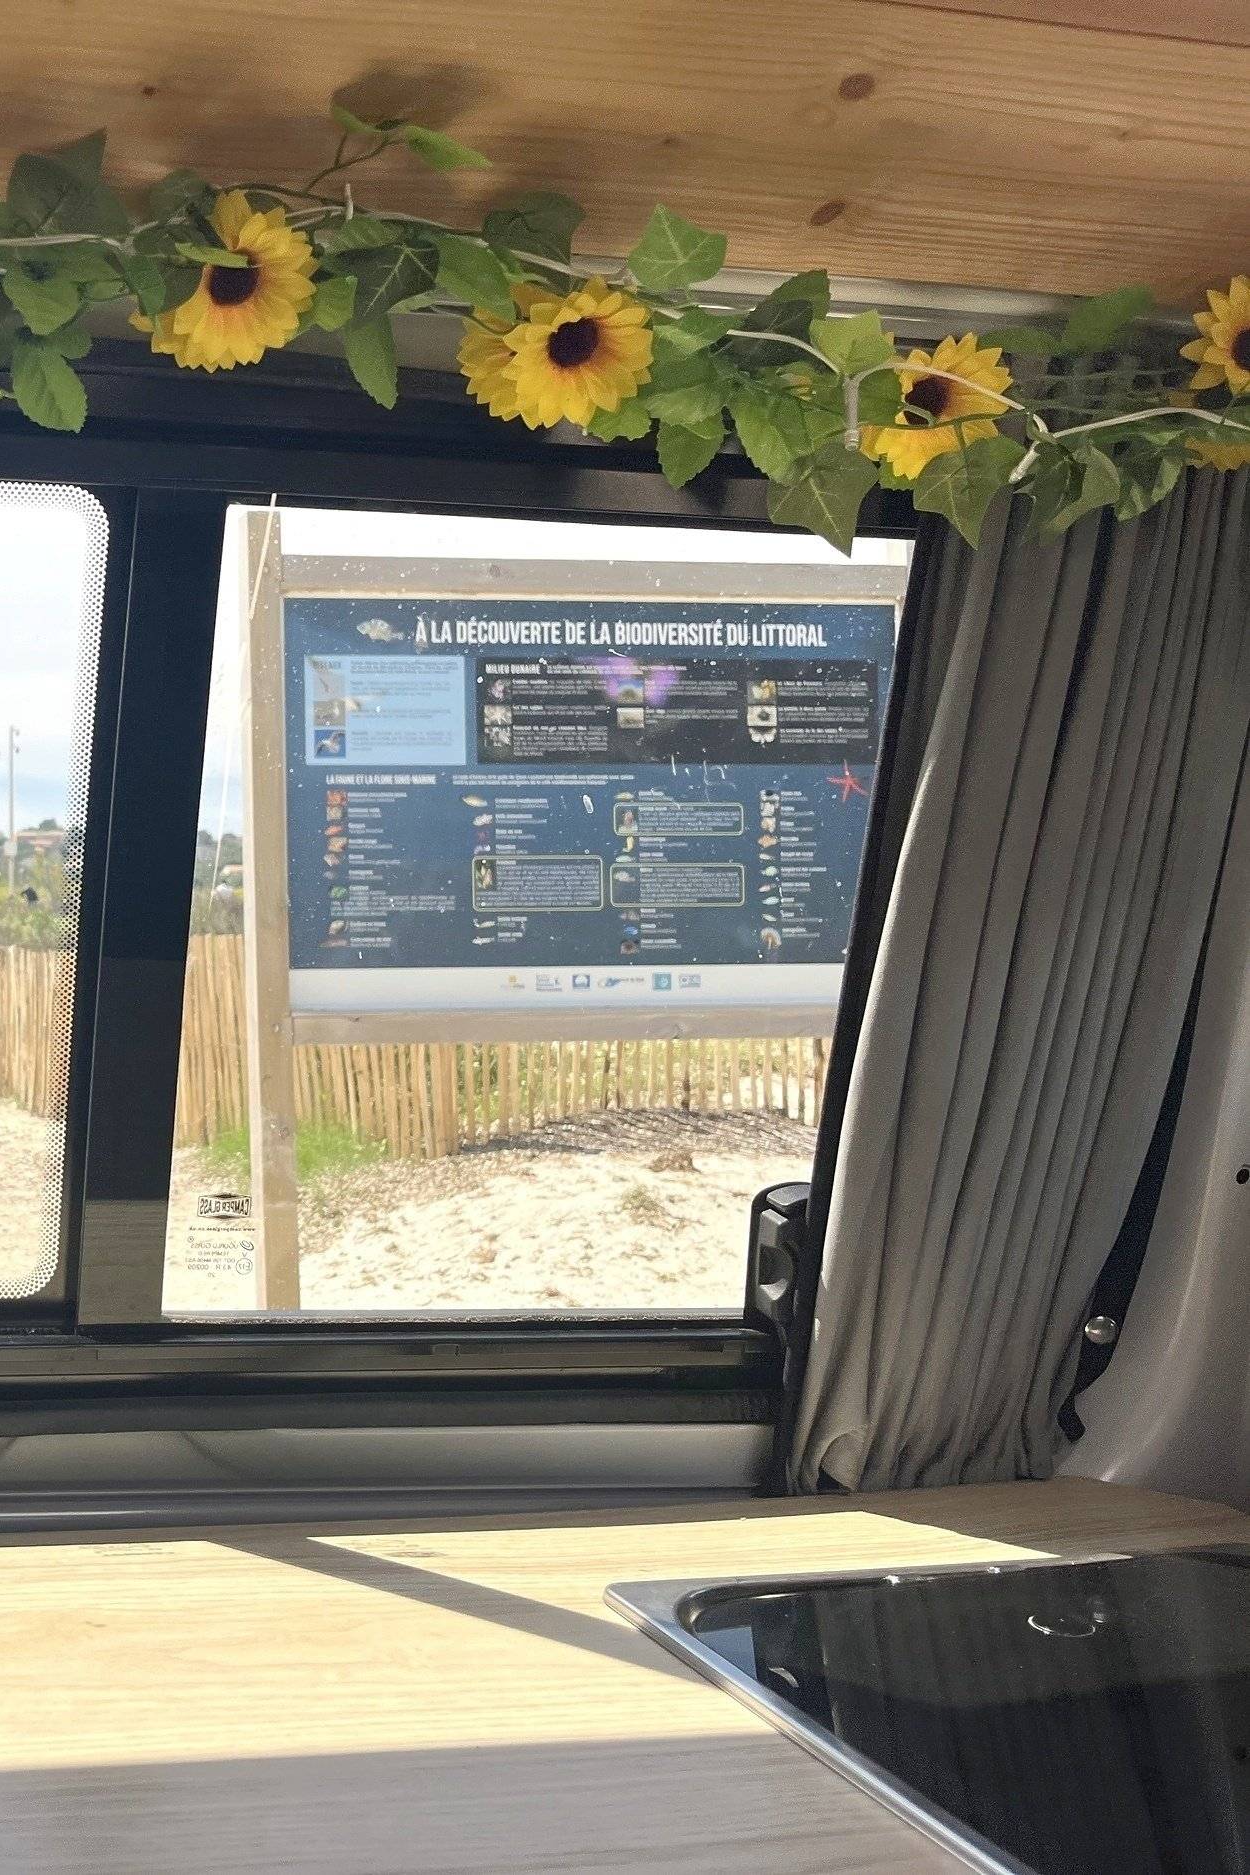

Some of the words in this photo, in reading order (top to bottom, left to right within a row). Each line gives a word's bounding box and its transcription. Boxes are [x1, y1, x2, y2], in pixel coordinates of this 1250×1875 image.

[415, 615, 427, 643] À
[430, 620, 452, 644] LA
[456, 616, 562, 645] DÉCOUVERTE
[565, 620, 587, 645] DE
[590, 620, 611, 645] LA
[615, 618, 723, 646] BIODIVERSITÉ
[726, 622, 748, 646] DU
[752, 623, 828, 648] LITTORAL
[485, 664, 510, 674] MILIEU
